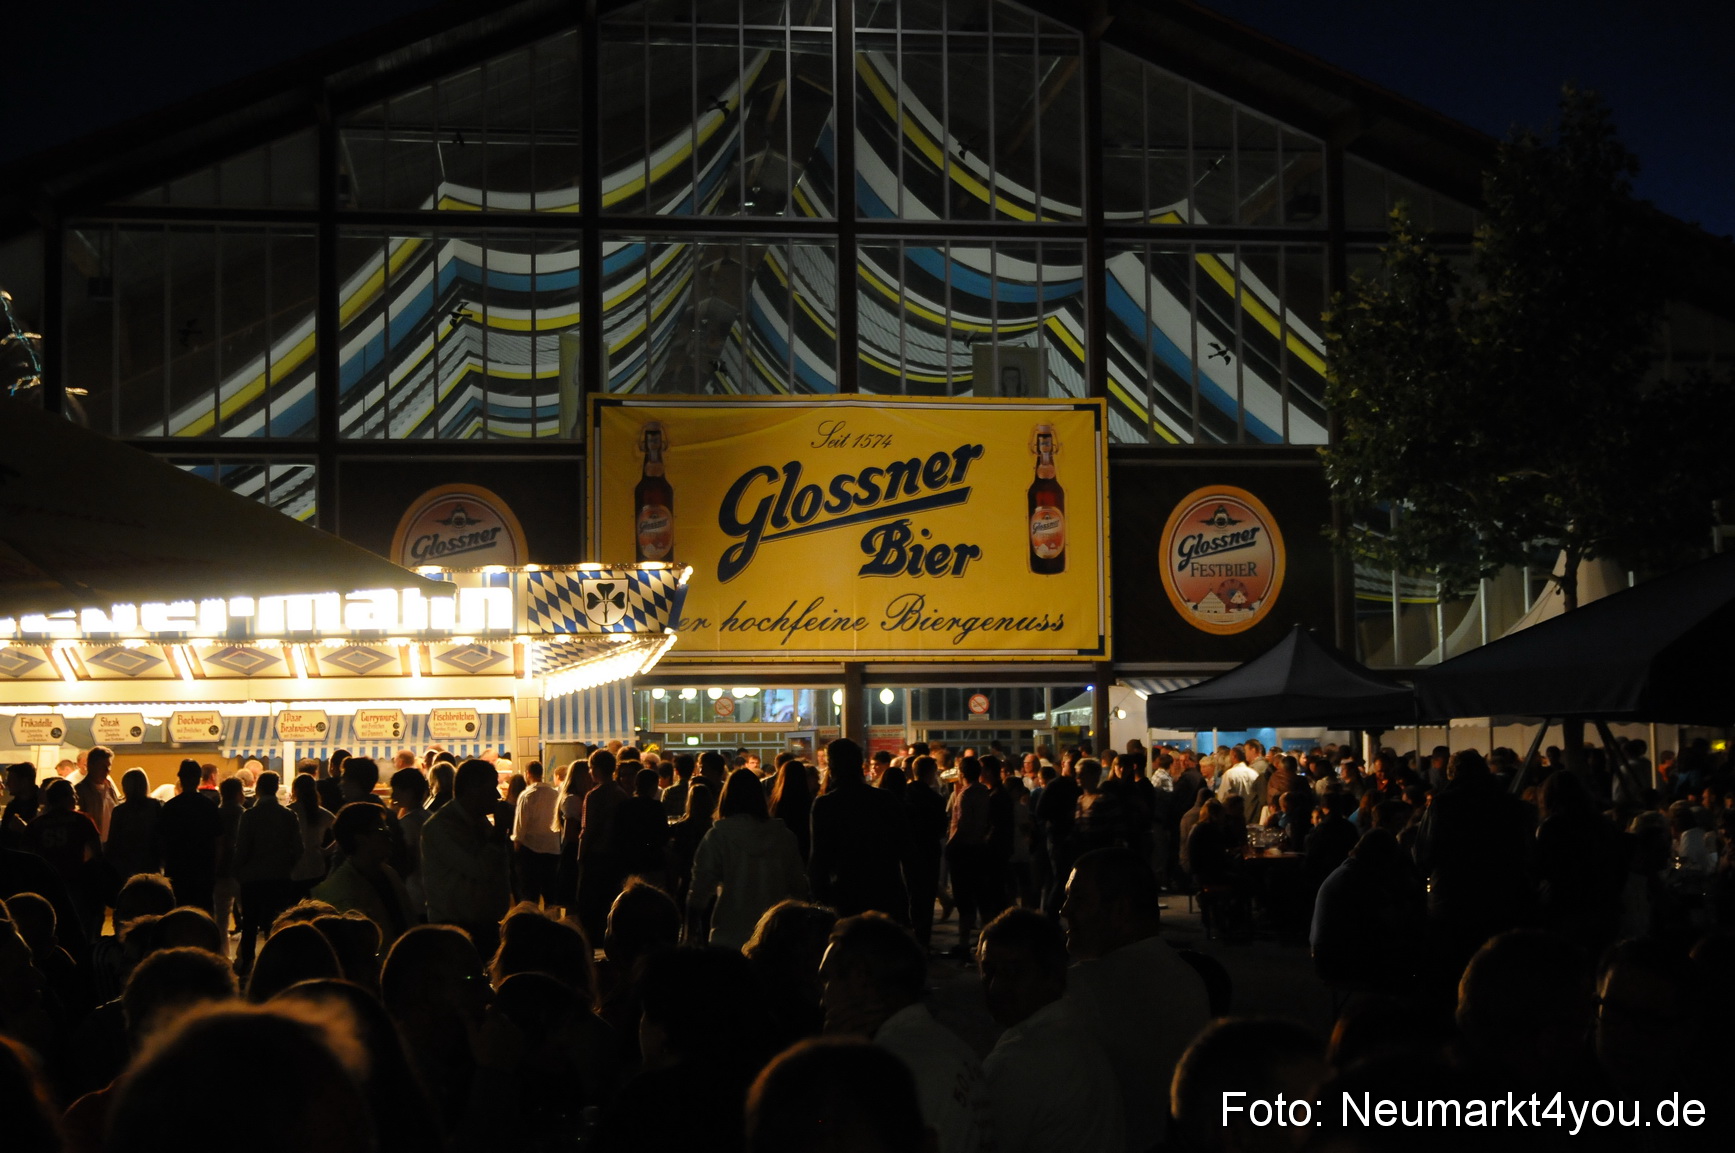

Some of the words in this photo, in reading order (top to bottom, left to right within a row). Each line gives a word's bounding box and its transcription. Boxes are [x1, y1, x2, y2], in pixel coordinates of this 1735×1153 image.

[810, 420, 851, 449] Seit
[852, 433, 895, 449] 1574
[717, 443, 985, 584] Glossner
[410, 526, 502, 567] Glossner
[857, 518, 983, 578] Bier
[1177, 526, 1260, 572] Glossner
[1190, 561, 1258, 578] FESTBIER
[677, 617, 711, 634] er
[722, 596, 869, 645] hochfeine
[880, 593, 1064, 645] Biergenuss
[100, 716, 120, 728] Steak
[177, 714, 212, 725] Bockwurst
[361, 711, 398, 724] Currywurst
